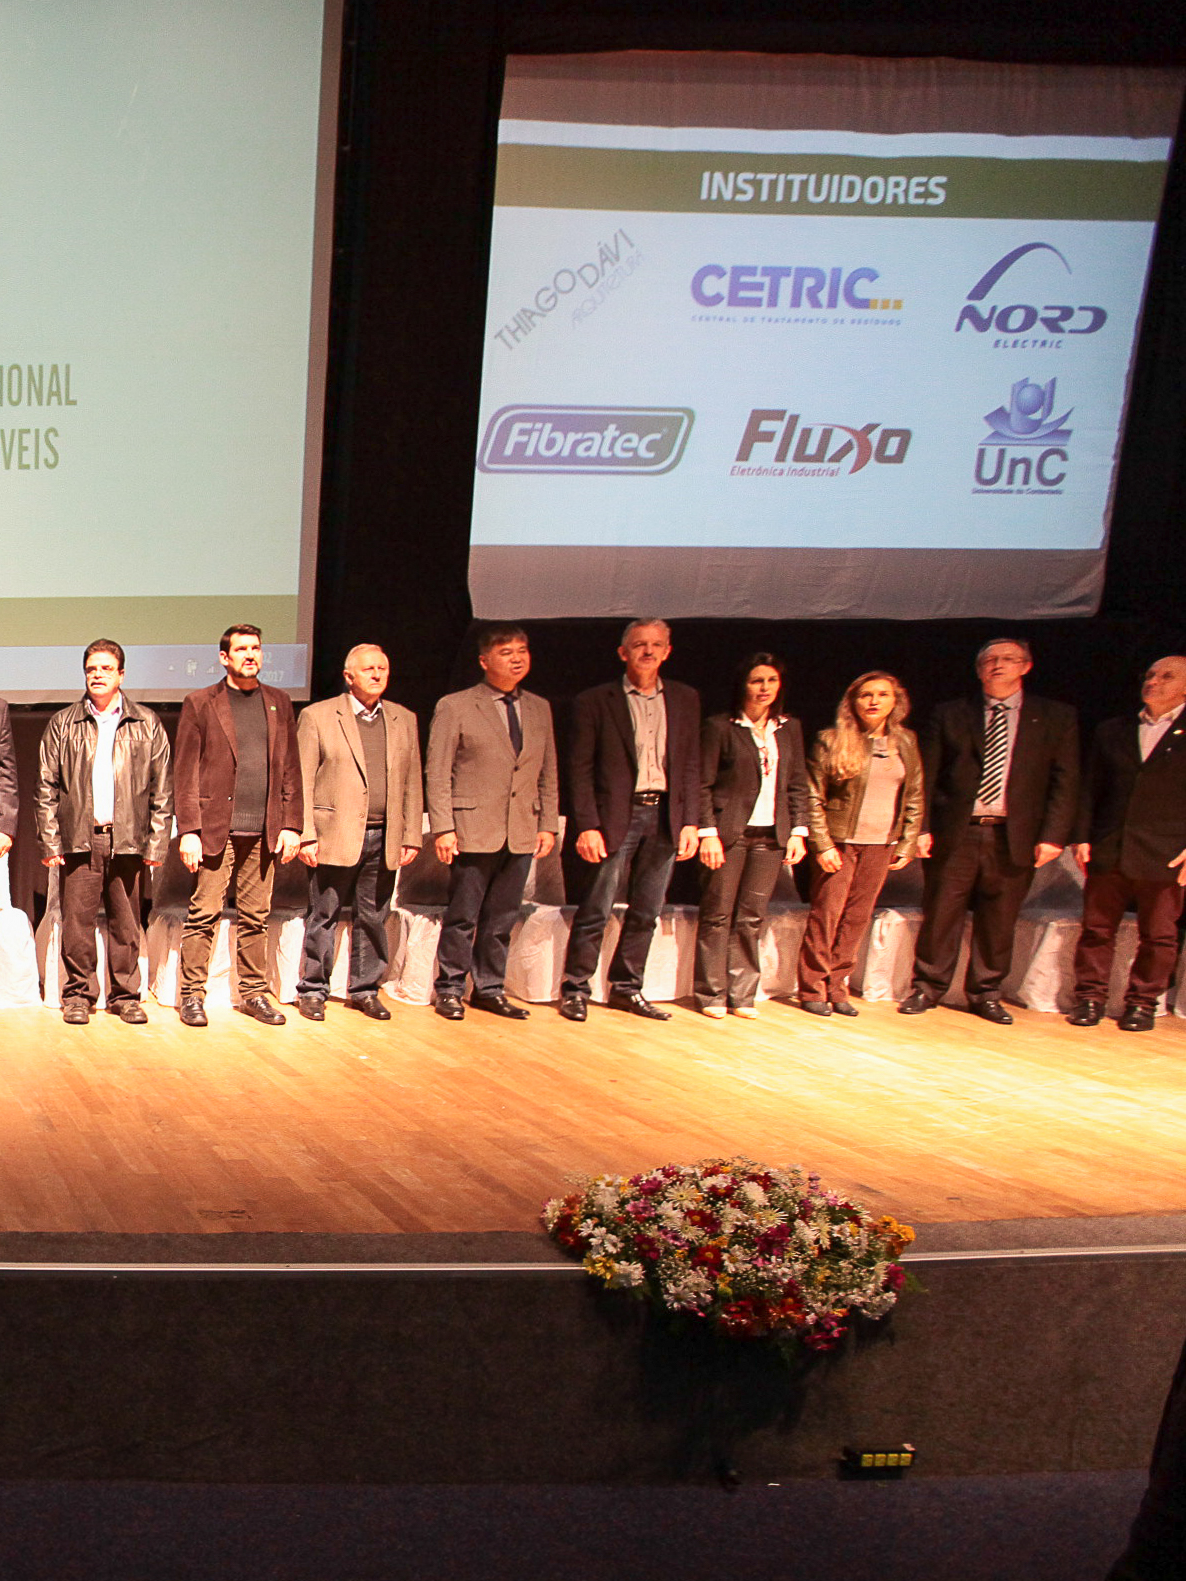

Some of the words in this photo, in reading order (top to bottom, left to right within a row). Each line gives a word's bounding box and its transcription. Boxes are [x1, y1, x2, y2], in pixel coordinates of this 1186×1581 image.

[700, 171, 947, 206] INSTITUIDORES
[954, 304, 1108, 334] NORD
[992, 338, 1064, 350] ELECTRIC
[503, 422, 664, 459] Fibratec
[787, 465, 841, 478] Industrial
[974, 447, 1069, 487] UnC
